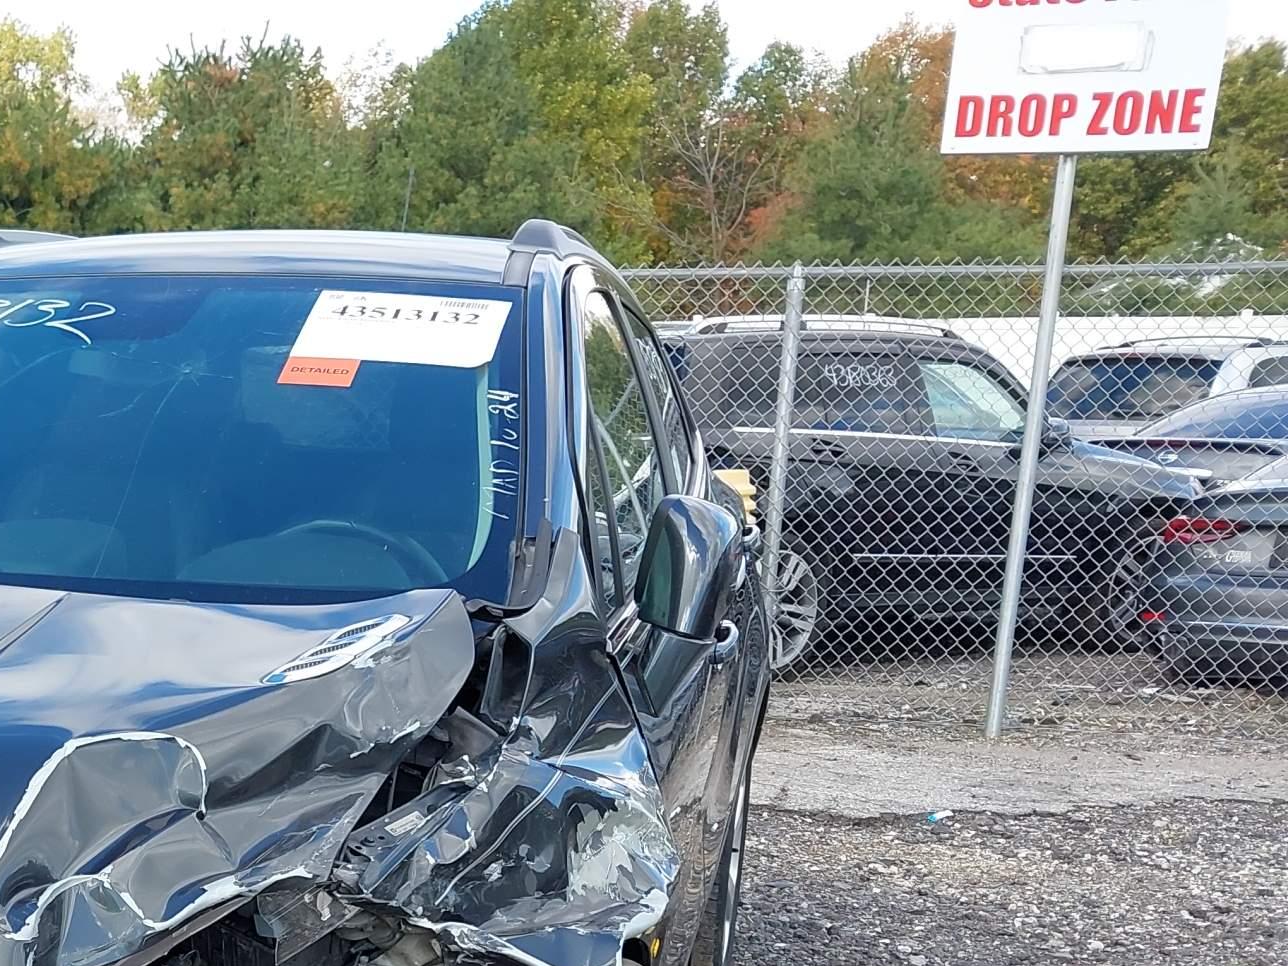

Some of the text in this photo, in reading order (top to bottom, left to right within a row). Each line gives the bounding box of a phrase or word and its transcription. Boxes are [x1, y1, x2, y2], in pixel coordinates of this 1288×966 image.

[955, 88, 1206, 137] DROP ZONE
[331, 305, 481, 325] 43513132
[290, 366, 350, 375] DETAILED
